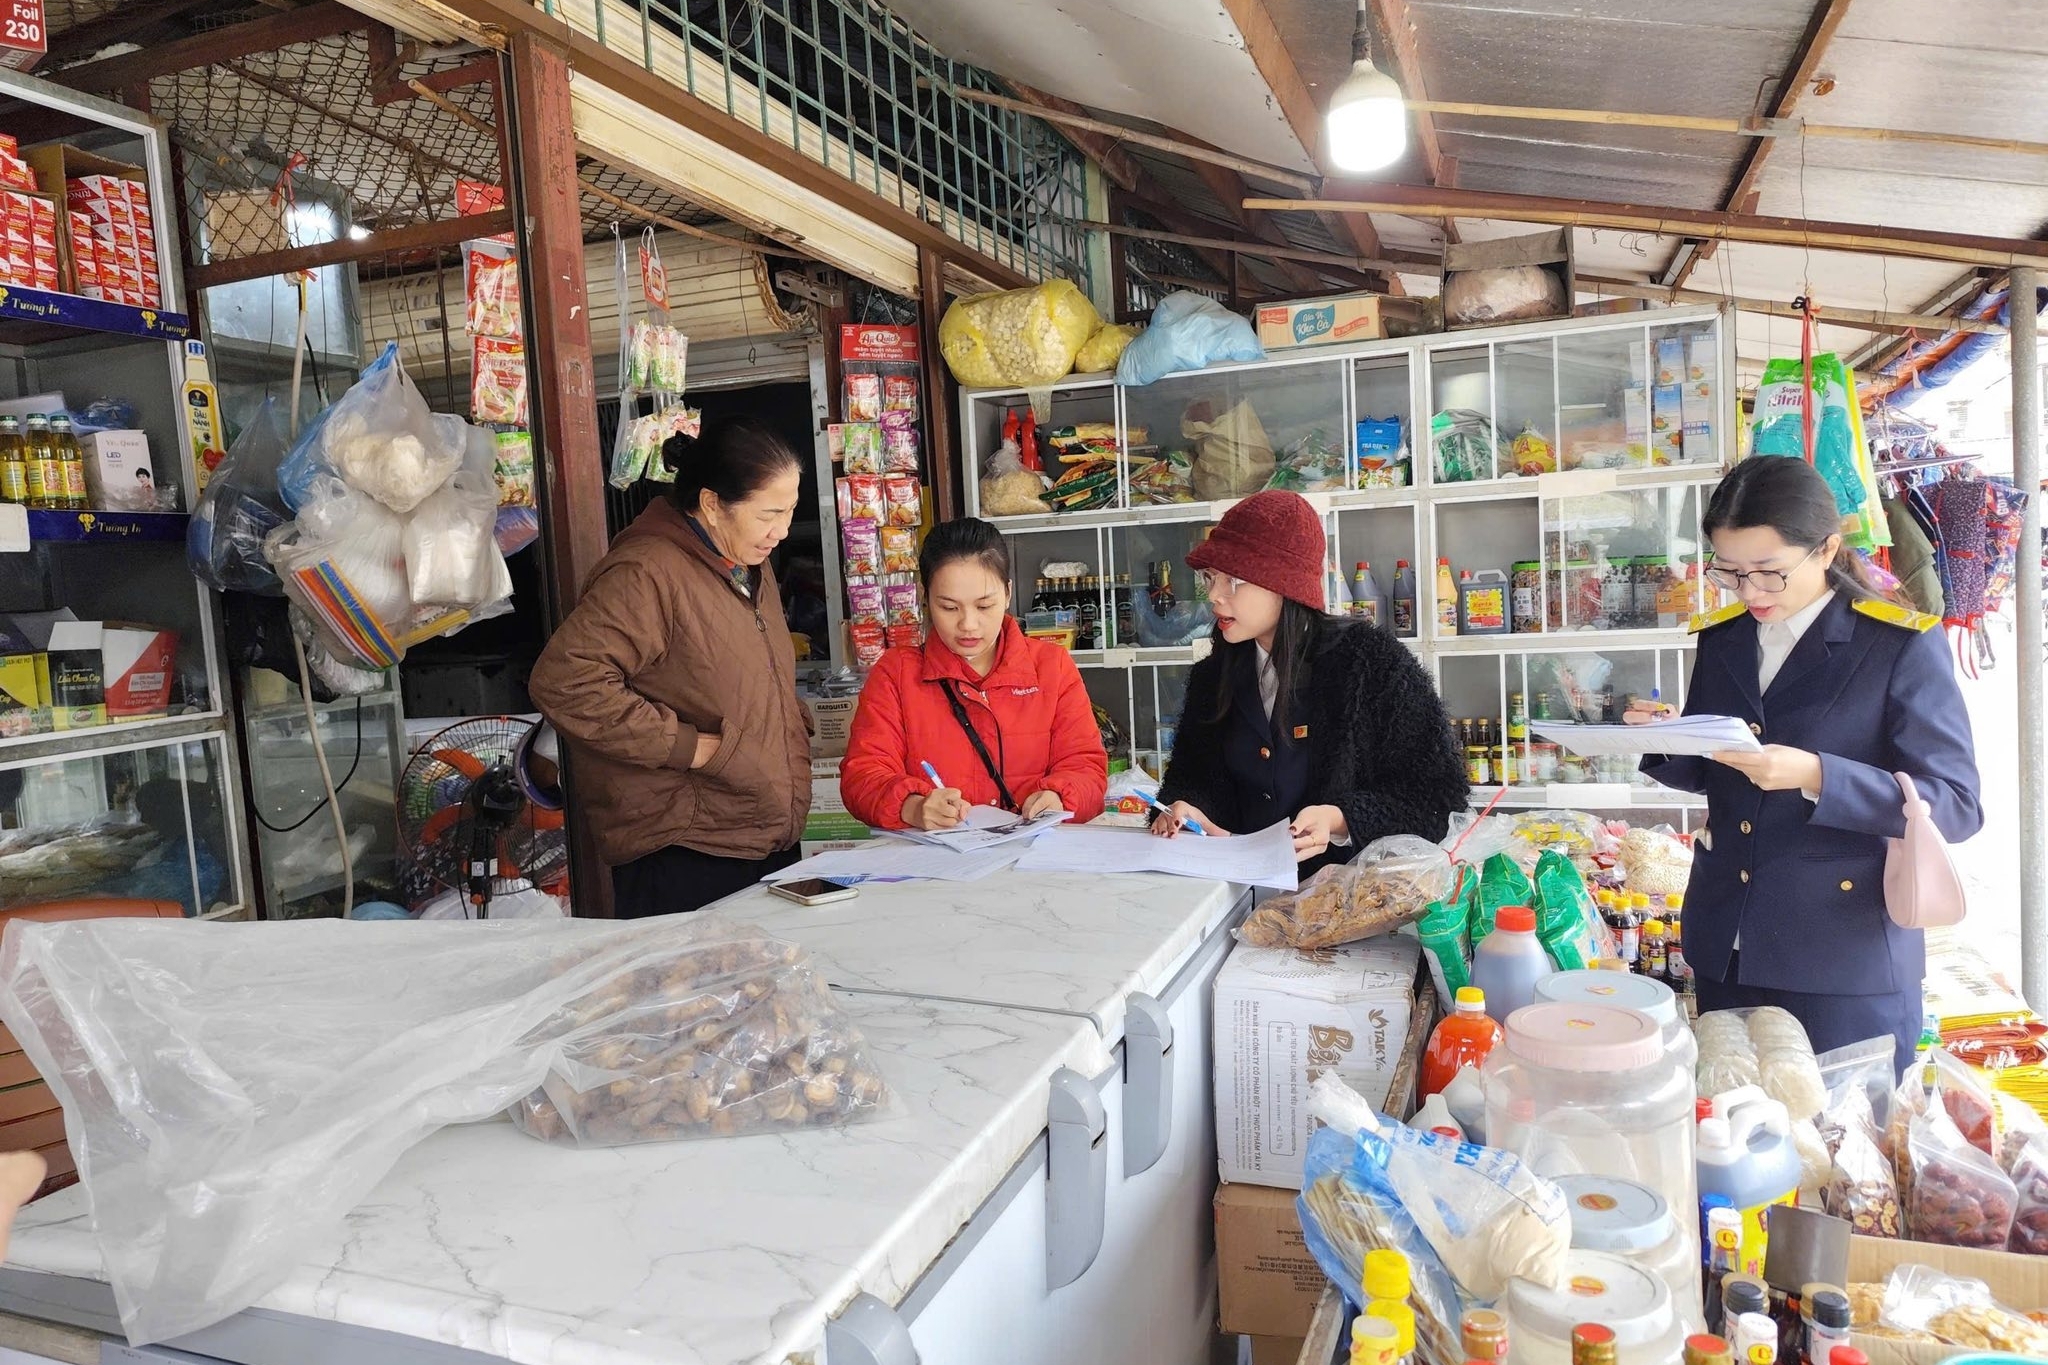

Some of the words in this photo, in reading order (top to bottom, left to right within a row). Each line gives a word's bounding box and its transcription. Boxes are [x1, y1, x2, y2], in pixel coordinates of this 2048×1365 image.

[13, 3, 39, 21] Foil
[5, 19, 40, 42] 230
[1296, 323, 1314, 335] Kho
[1781, 386, 1802, 394] Super
[1768, 395, 1804, 407] Nitril
[1252, 1037, 1261, 1056] CÔNG
[1253, 1057, 1260, 1065] TY
